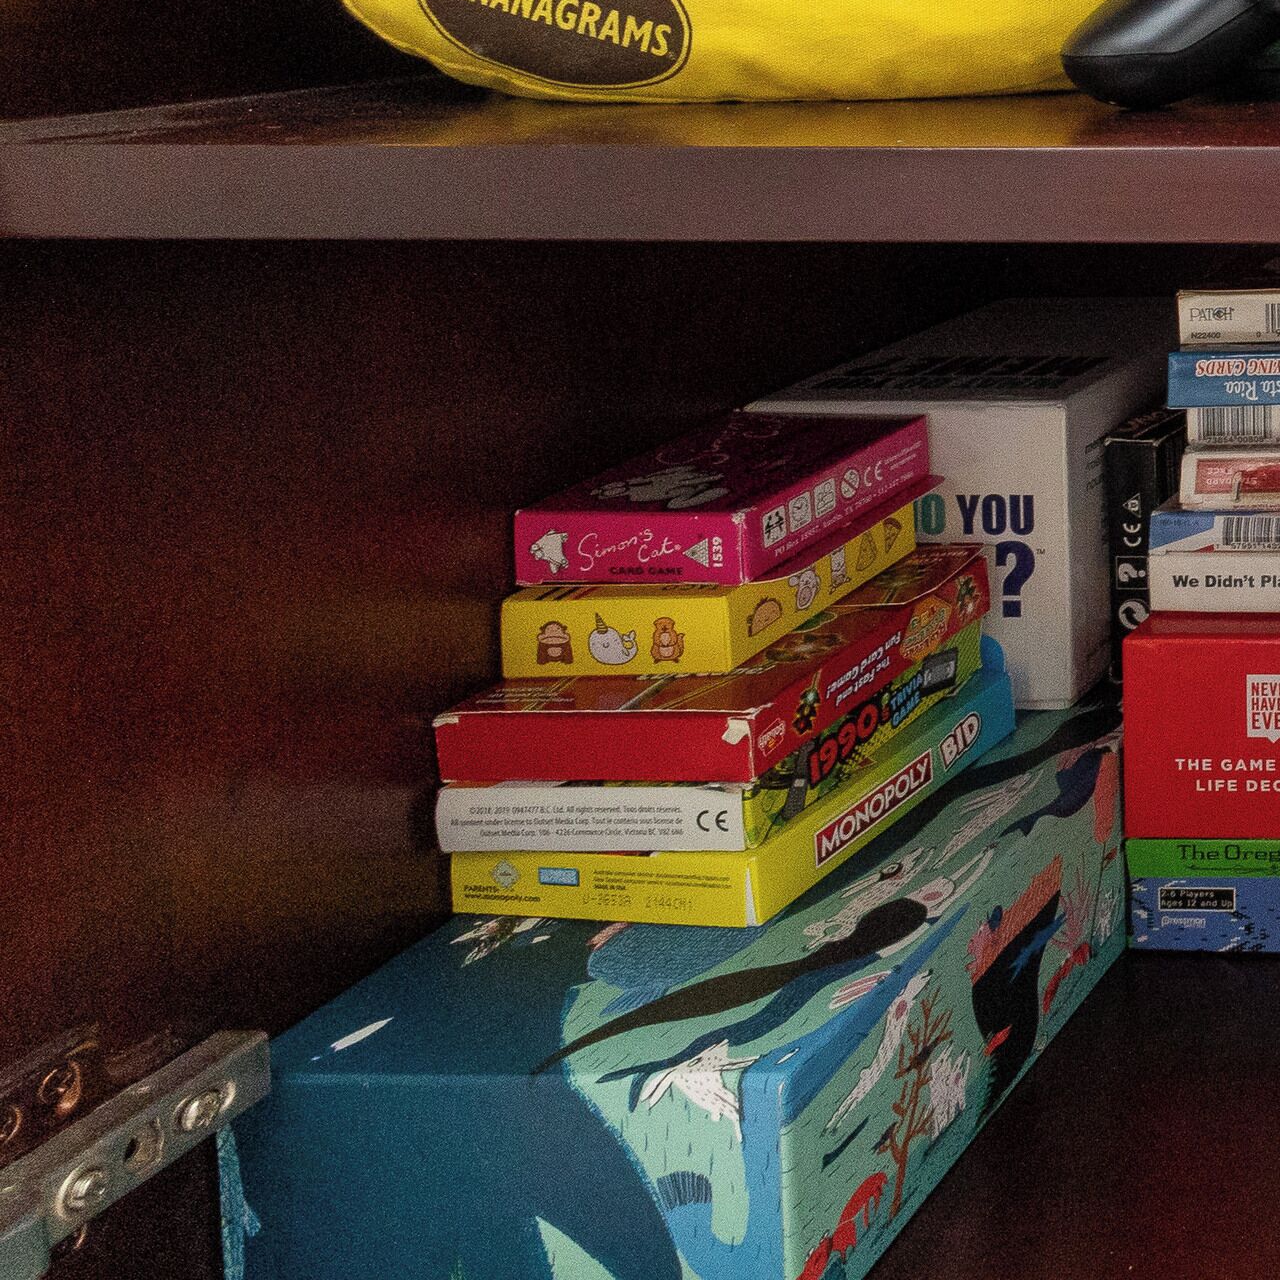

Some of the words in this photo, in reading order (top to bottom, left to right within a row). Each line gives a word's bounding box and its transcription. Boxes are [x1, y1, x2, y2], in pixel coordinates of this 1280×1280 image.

[1196, 359, 1247, 377] CARDS
[956, 494, 1035, 535] YOU
[712, 536, 724, 568] 1539
[1173, 574, 1200, 589] We
[1204, 573, 1255, 589] Didn't
[1175, 758, 1216, 772] THE
[1222, 758, 1280, 772] GAME
[818, 759, 932, 858] MONOPOLY
[940, 713, 981, 772] BID
[1195, 779, 1240, 794] LIFE
[1177, 844, 1220, 860] The
